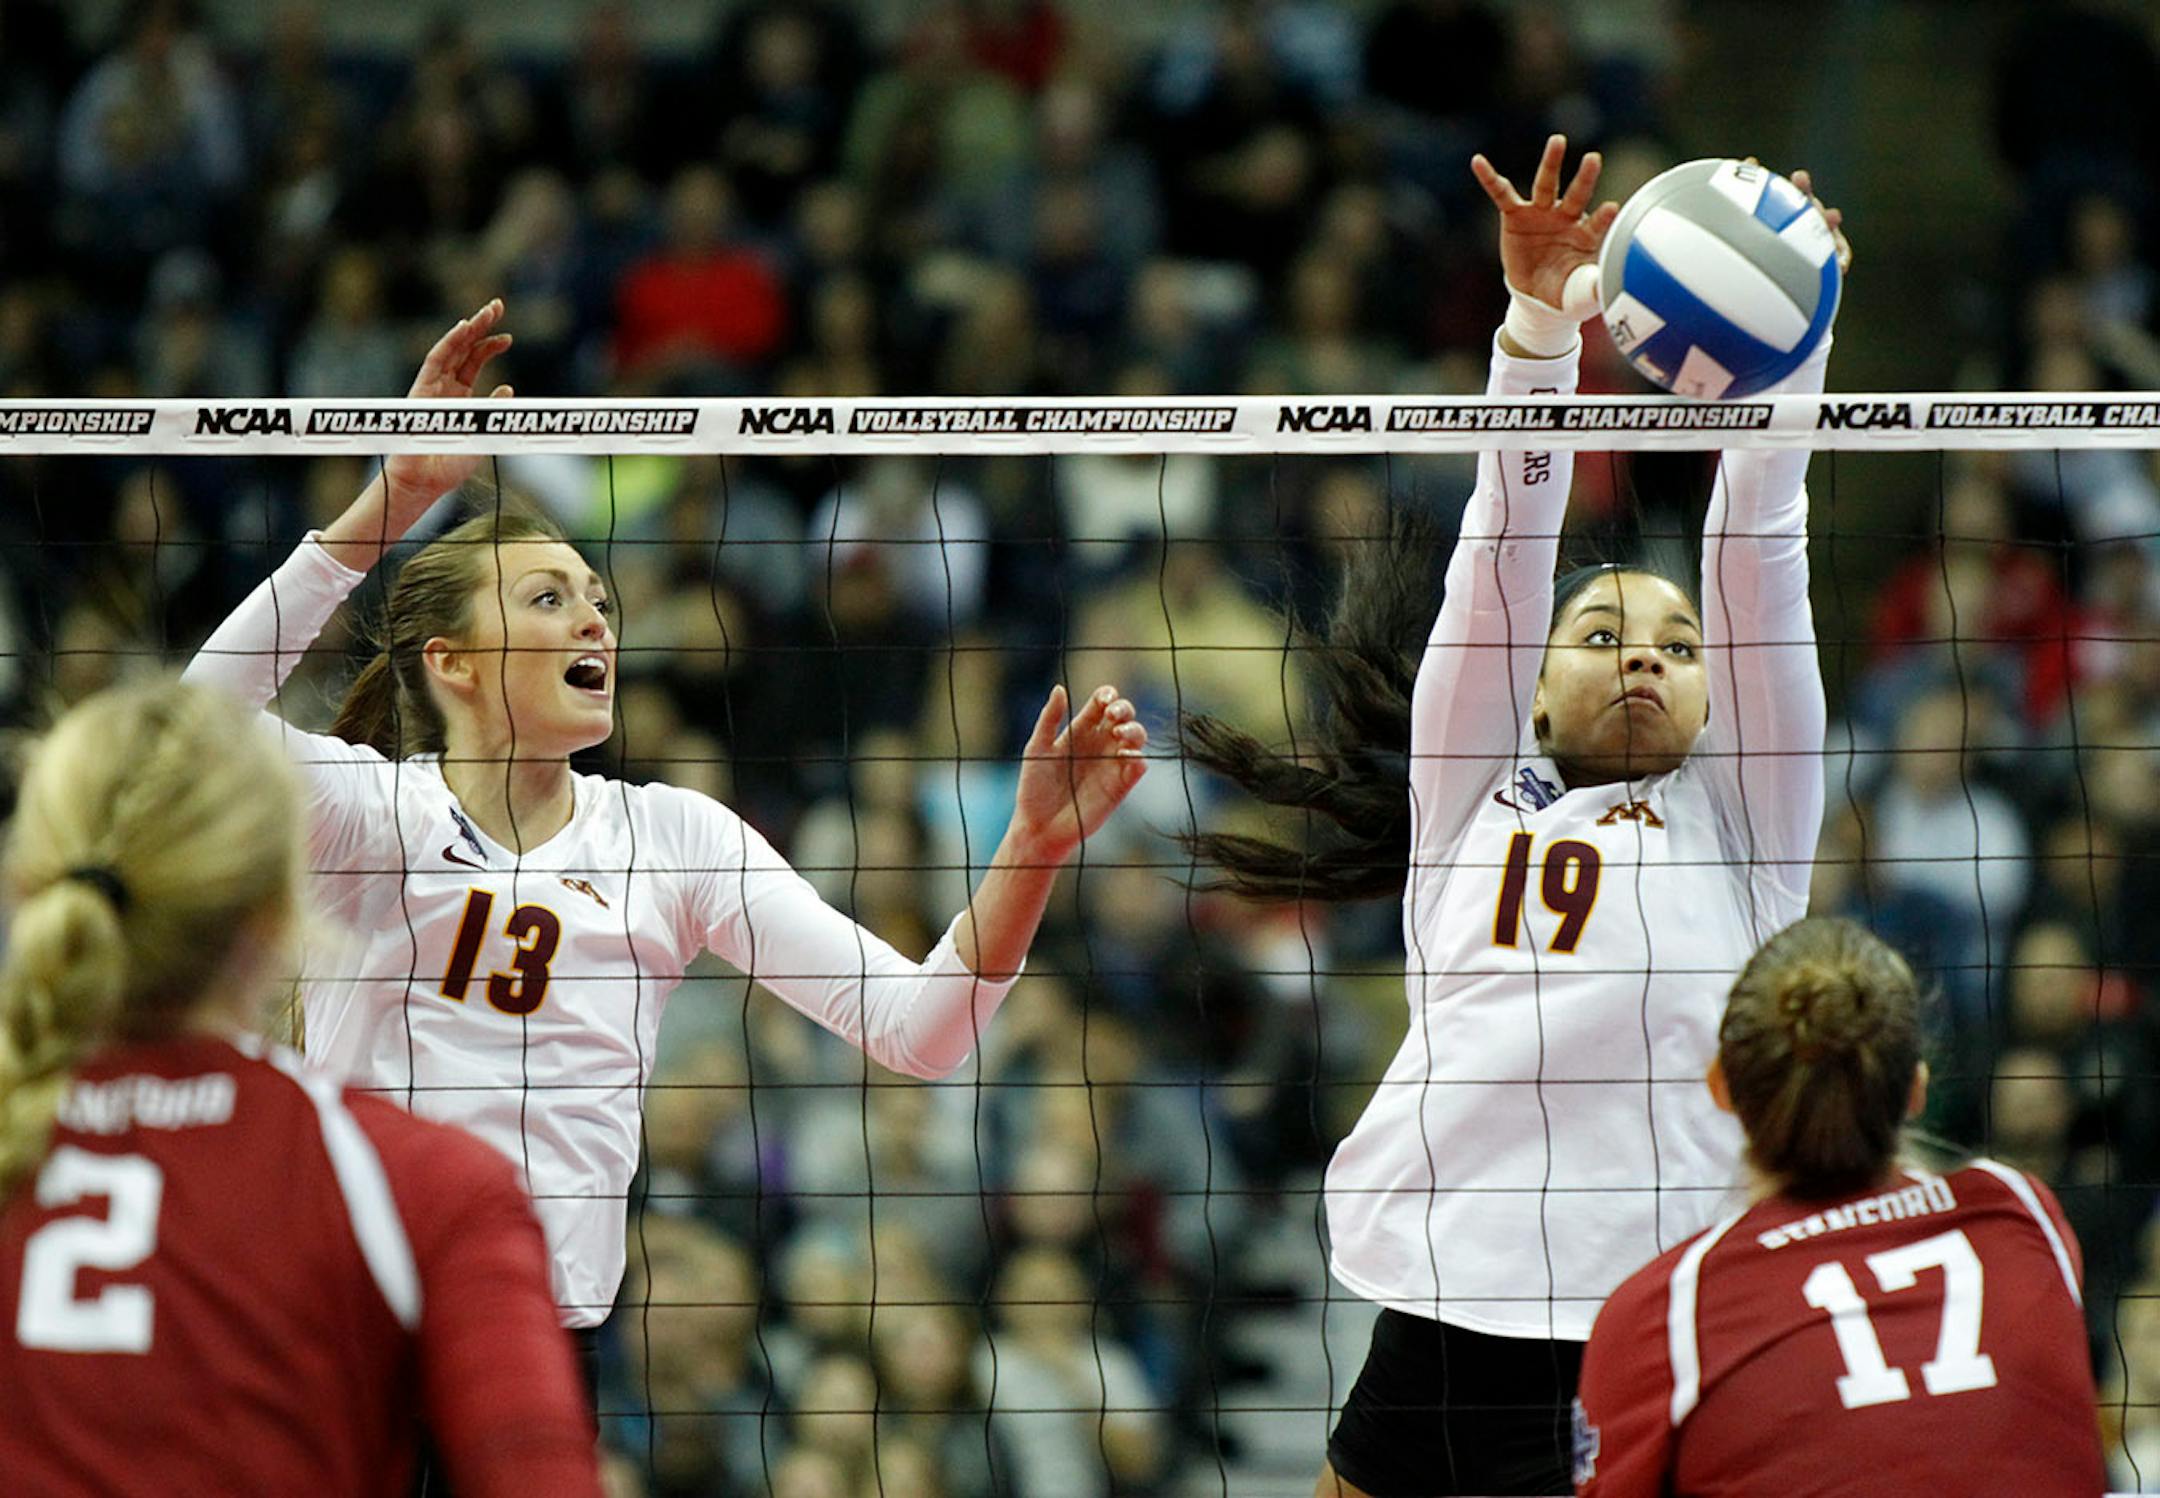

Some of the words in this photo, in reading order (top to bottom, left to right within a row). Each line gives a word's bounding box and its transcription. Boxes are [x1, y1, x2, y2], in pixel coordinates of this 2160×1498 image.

[194, 408, 293, 434] NCAA
[313, 411, 479, 433] VOLLEYBALL
[485, 410, 694, 433] CHAMPIONSHIP
[738, 408, 835, 434] NCAA
[855, 410, 1018, 432] VOLLEYBALL
[1025, 409, 1232, 431] CHAMPIONSHIP
[1276, 406, 1372, 432] NCAA
[1392, 408, 1555, 429] VOLLEYBALL
[1562, 407, 1770, 428] CHAMPIONSHIP
[1816, 403, 1913, 429] NCAA
[1932, 405, 2097, 427] VOLLEYBALL
[2102, 404, 2160, 427] CHA
[1492, 831, 1604, 955] 19
[439, 887, 562, 1016] 13
[16, 1146, 163, 1353] 2
[1802, 1229, 1998, 1409] 17
